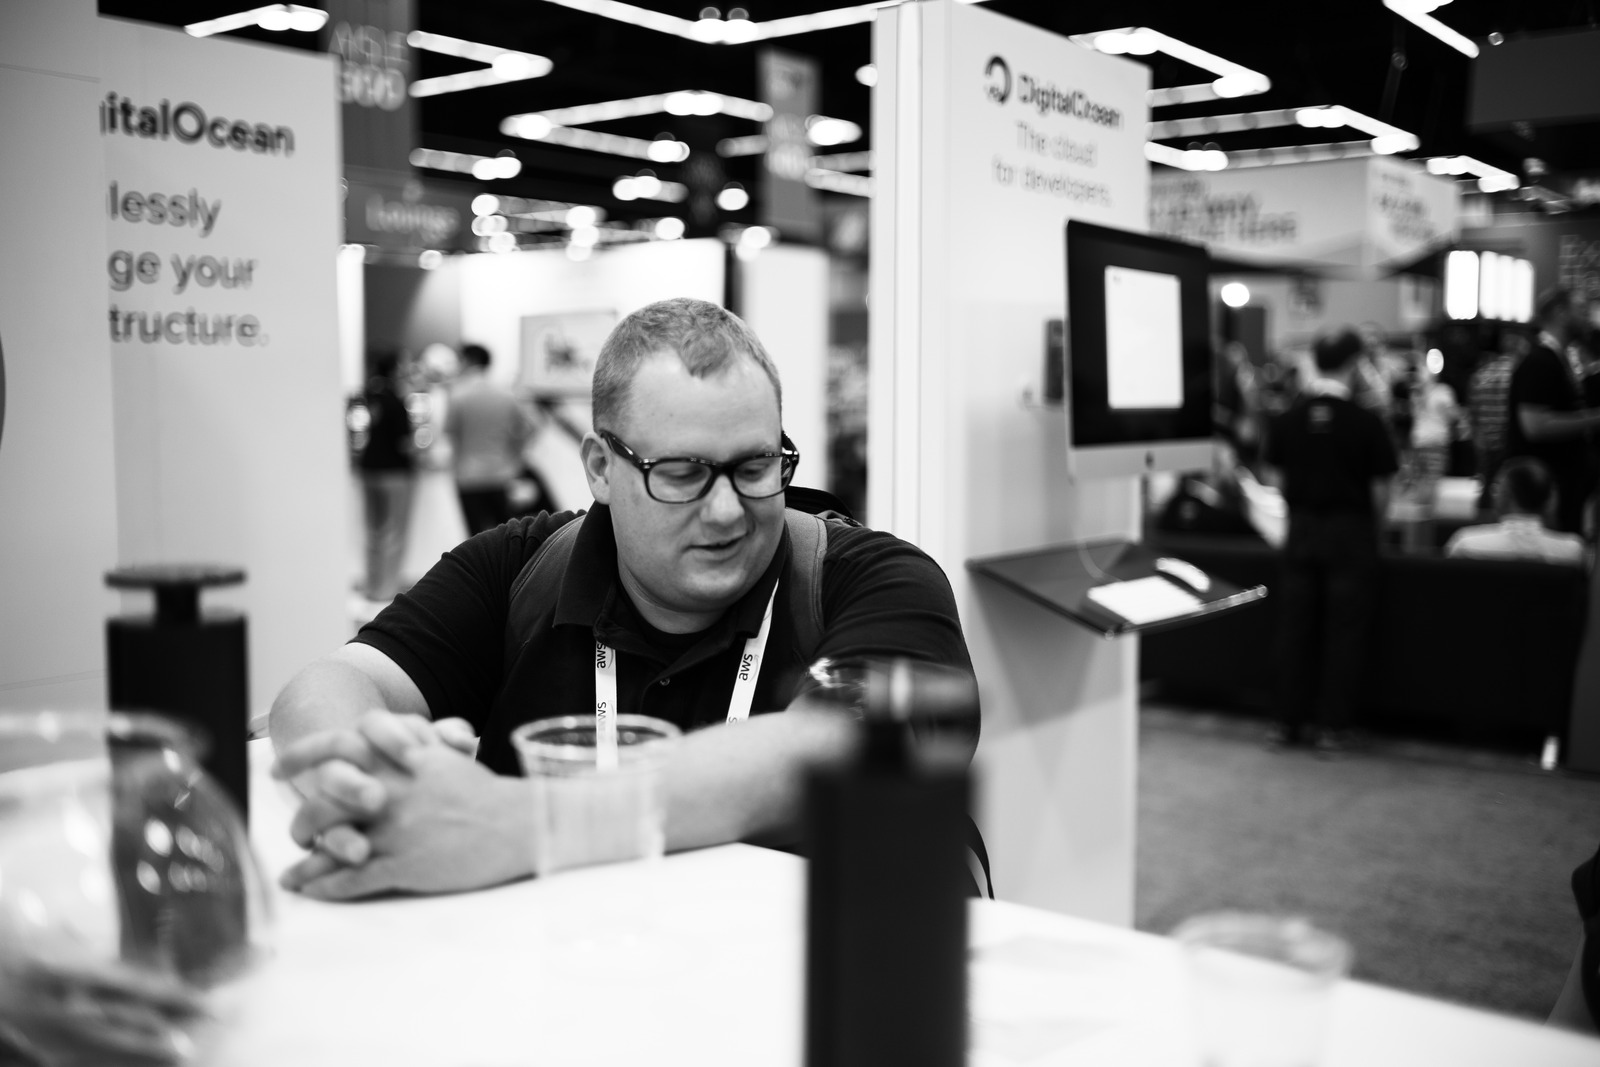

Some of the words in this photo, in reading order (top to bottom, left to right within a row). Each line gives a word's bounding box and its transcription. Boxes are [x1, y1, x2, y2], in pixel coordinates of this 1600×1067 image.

[109, 180, 222, 239] lessly
[107, 250, 161, 292] ge
[170, 253, 259, 295] your
[596, 642, 607, 669] aws
[738, 653, 754, 681] aws
[597, 701, 607, 726] ws
